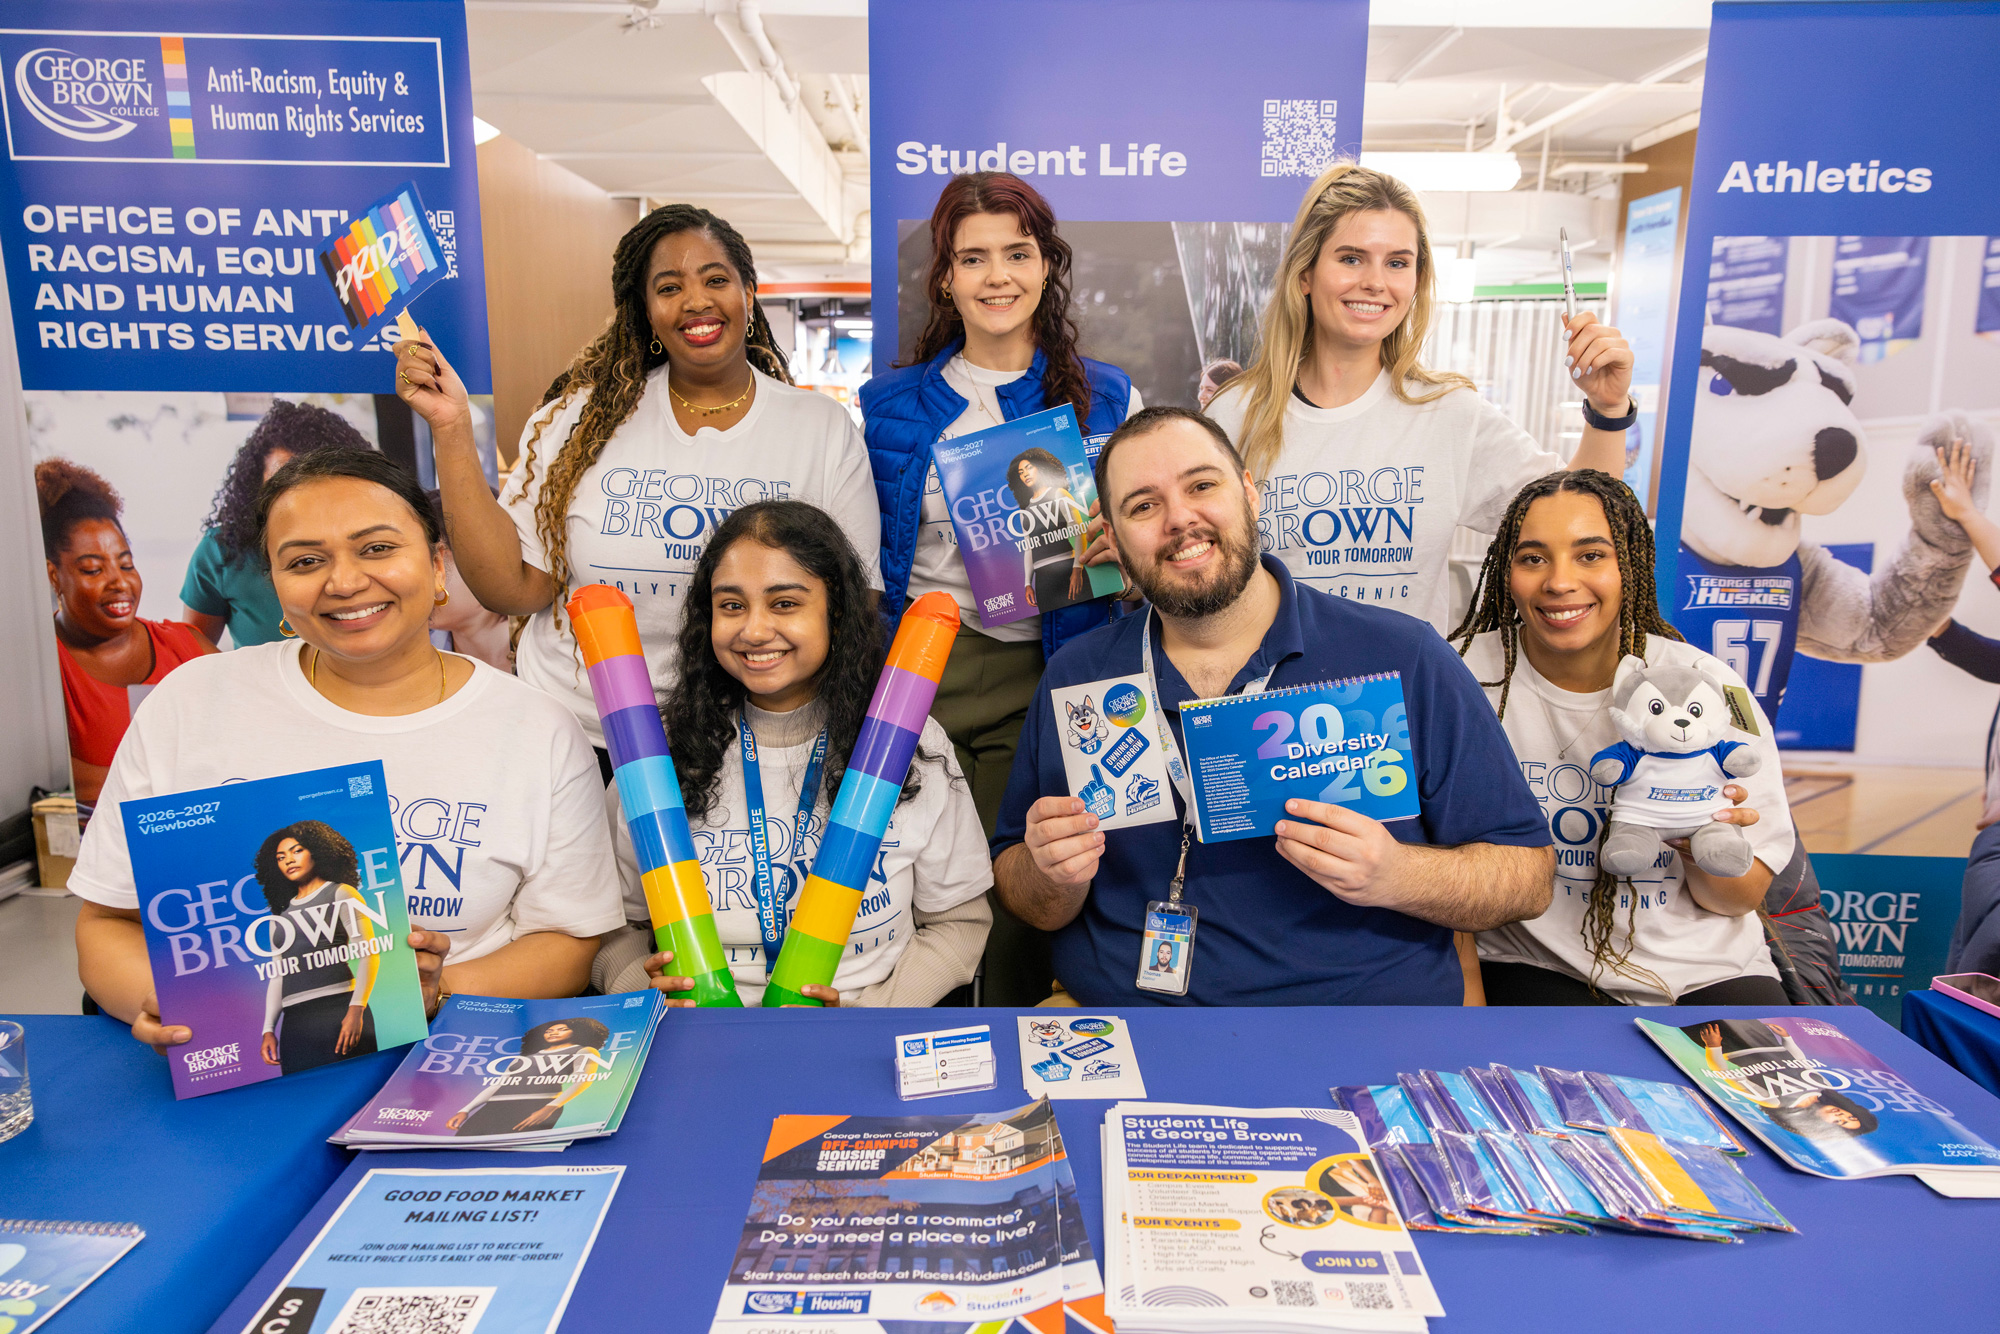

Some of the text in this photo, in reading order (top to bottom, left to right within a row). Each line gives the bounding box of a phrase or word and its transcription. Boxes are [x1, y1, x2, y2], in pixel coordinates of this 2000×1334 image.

[34, 56, 146, 82] GEORGE
[207, 66, 409, 101] Anti-Racism, Equity &
[52, 80, 153, 106] BROWN
[110, 106, 160, 117] COLLEGE
[210, 105, 425, 138] Human Rights Services
[896, 141, 1188, 177] Student Life
[1717, 160, 1933, 193] Athletics
[22, 204, 175, 235] OFFICE
[185, 208, 241, 236] OF
[28, 244, 316, 278] RACISM, EQUI
[335, 215, 419, 305] PRIDE
[390, 241, 423, 269] @GBC
[35, 284, 293, 313] AND HUMAN
[39, 322, 196, 349] RIGHTS
[940, 439, 984, 458] 2026–2027
[942, 448, 983, 465] Viewbook
[601, 467, 791, 506] GEORGE
[1255, 466, 1424, 516] GEORGE
[966, 491, 1090, 553] BROWN
[1257, 507, 1415, 552] BROWN
[664, 543, 701, 561] YOUR
[1014, 537, 1042, 553] YOUR
[1306, 546, 1414, 566] YOUR TOMORROW
[1700, 577, 1792, 589] GEORGE BROWN
[983, 592, 1014, 608] GEORGE
[987, 598, 1015, 613] BROWN
[1712, 619, 1783, 697] 67
[1108, 691, 1137, 708] GEORGE
[1112, 699, 1139, 714] BROWN
[1086, 744, 1098, 754] 67
[1106, 741, 1129, 767] OWNING
[1125, 732, 1138, 745] MY
[1287, 733, 1389, 760] Diversity
[1113, 739, 1145, 773] TOMORROW
[1270, 755, 1373, 781] Calendar
[298, 787, 344, 801] georgebrown.ca
[1093, 787, 1108, 802] GO
[137, 801, 221, 825] 2026–2027
[1096, 805, 1111, 817] GO
[139, 813, 216, 836] Viewbook
[1556, 850, 1595, 867] YOUR
[751, 808, 777, 942] @GBC.STUDENTLIFE
[167, 891, 389, 978] BROWN
[254, 933, 394, 981] YOUR TOMORROW
[1839, 953, 1906, 968] TOMORROW
[455, 1004, 515, 1014] Viewbook
[457, 999, 524, 1010] 2026–2027
[183, 1042, 240, 1066] GEORGE
[188, 1052, 240, 1074] BROWN
[416, 1050, 621, 1076] BROWN
[1701, 1058, 1827, 1080] YOUR TOMORROW
[481, 1071, 614, 1087] YOUR TOMORROW
[1714, 1066, 1916, 1101] BROWN
[377, 1112, 430, 1122] BROWN
[378, 1107, 434, 1117] GEORGE
[1125, 1118, 1249, 1130] Student Life
[821, 1138, 919, 1150] OFF-CAMPUS
[823, 1132, 861, 1140] George
[894, 1130, 939, 1139] College's
[1126, 1129, 1302, 1142] at George Brown
[819, 1149, 886, 1161] HOUSING
[816, 1159, 880, 1172] SERVICE
[982, 1169, 1018, 1180] Simplified
[384, 1189, 587, 1203] GOOD FOOD MARKET
[404, 1210, 539, 1223] MAILING LIST!
[778, 1208, 1023, 1229] Do you need a roommate?
[1165, 1219, 1220, 1227] EVENTS
[759, 1221, 1036, 1245] Do you need a place to live?
[359, 1242, 544, 1251] JOIN OUR MAILING LIST TO RECEIVE
[327, 1252, 564, 1263] WEEKLY PRICE LISTS EARLY OR PRE-ORDER!
[1315, 1257, 1378, 1267] JOIN US
[742, 1270, 774, 1281] Start
[776, 1272, 805, 1283] your
[808, 1270, 851, 1281] search
[853, 1269, 892, 1281] today
[895, 1269, 910, 1280] at
[811, 1297, 862, 1312] Housing
[967, 1295, 1032, 1310] Students
